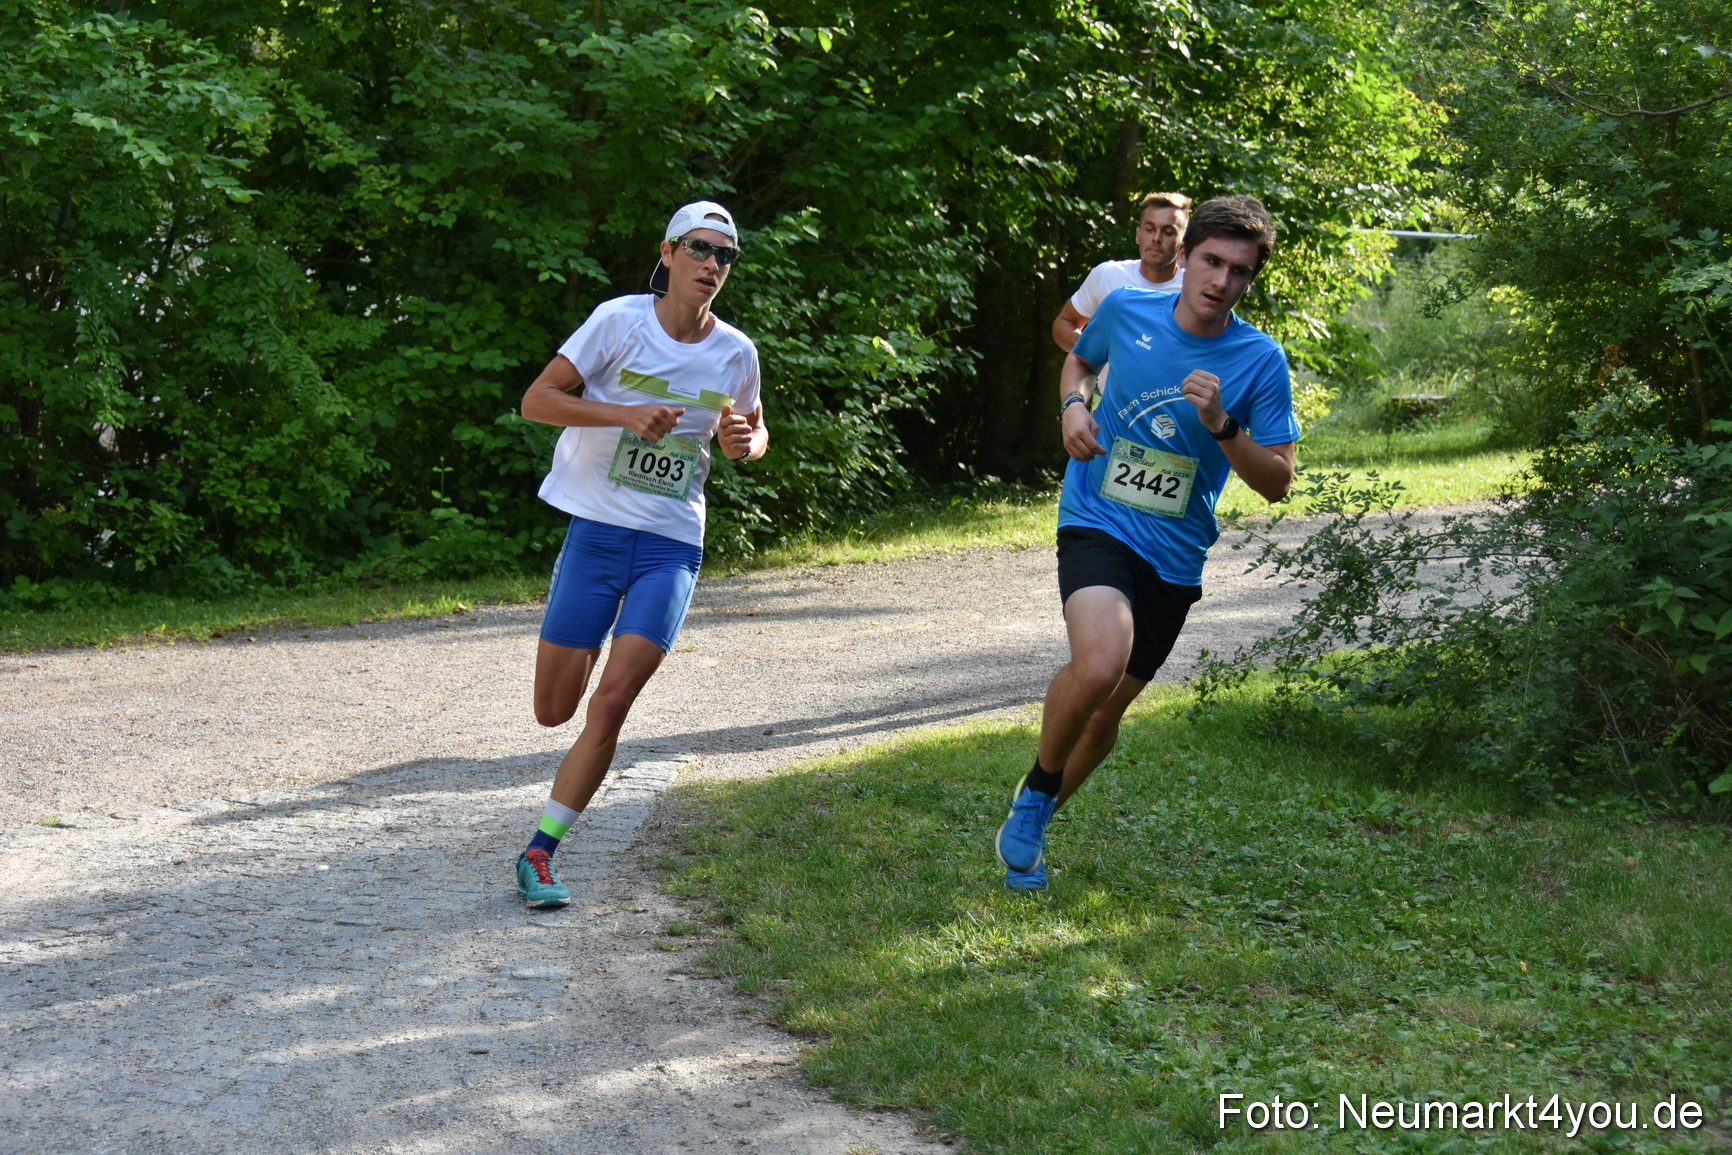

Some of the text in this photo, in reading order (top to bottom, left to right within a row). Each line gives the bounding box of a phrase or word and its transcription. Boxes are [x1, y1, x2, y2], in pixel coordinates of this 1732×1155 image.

[1135, 339, 1151, 350] erima
[1140, 385, 1181, 401] Schick
[627, 447, 685, 482] 1093
[658, 478, 674, 488] Elena
[1113, 462, 1181, 499] 2442
